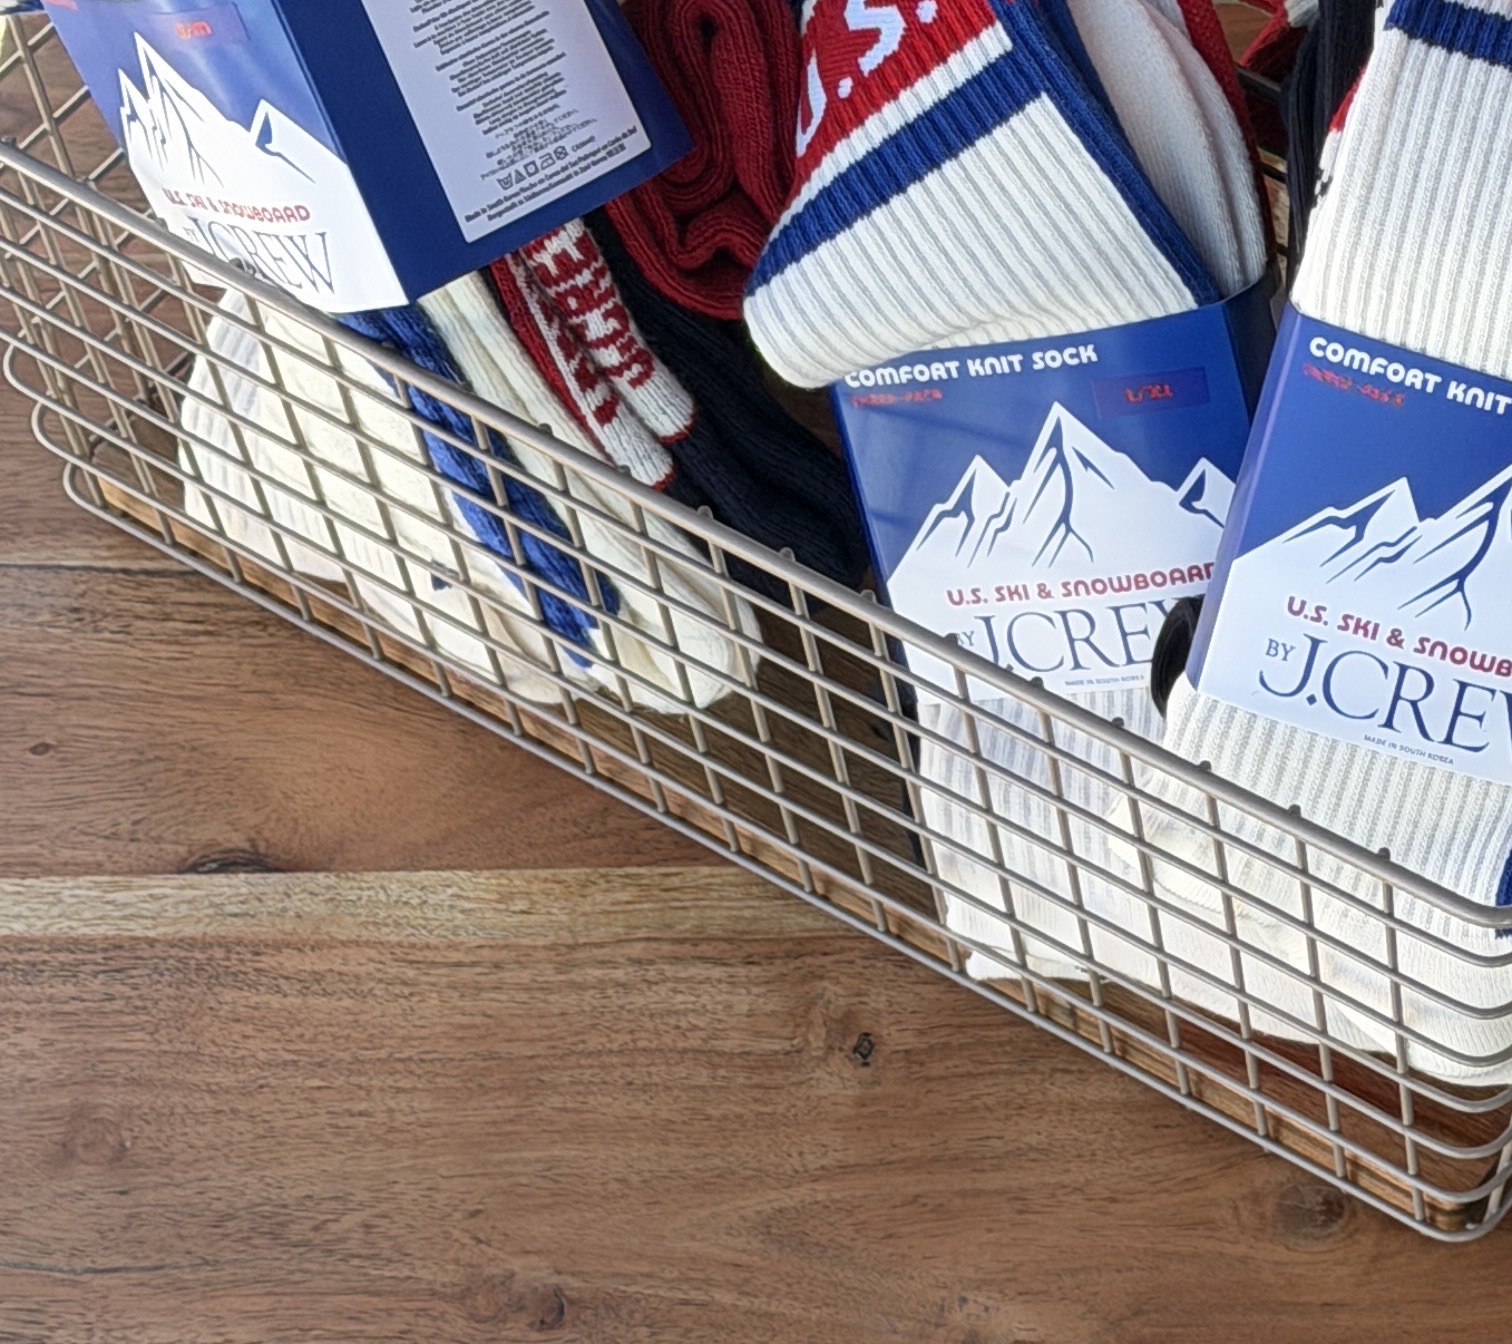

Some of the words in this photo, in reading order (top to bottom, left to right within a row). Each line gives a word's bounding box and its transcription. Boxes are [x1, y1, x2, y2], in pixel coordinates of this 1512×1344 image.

[217, 199, 311, 224] SNOWBOARD
[186, 215, 336, 295] JCREW
[530, 228, 656, 389] J.CRE
[844, 360, 960, 389] COMFORT
[966, 353, 1024, 378] KNIT
[1032, 344, 1098, 370] SOCK
[1309, 336, 1442, 393] COMFORT
[1446, 380, 1512, 414] KNIT
[945, 587, 989, 607] U.S.
[994, 583, 1031, 602] SKI
[1036, 582, 1055, 599] &
[973, 598, 1172, 674] J.CRE
[1286, 595, 1329, 626] U.S.
[1337, 613, 1380, 640] SKI
[1386, 628, 1405, 649] &
[1265, 638, 1297, 662] BY
[1363, 733, 1388, 747] MADE
[1388, 740, 1398, 750] IN
[1399, 744, 1427, 758] SOUTH
